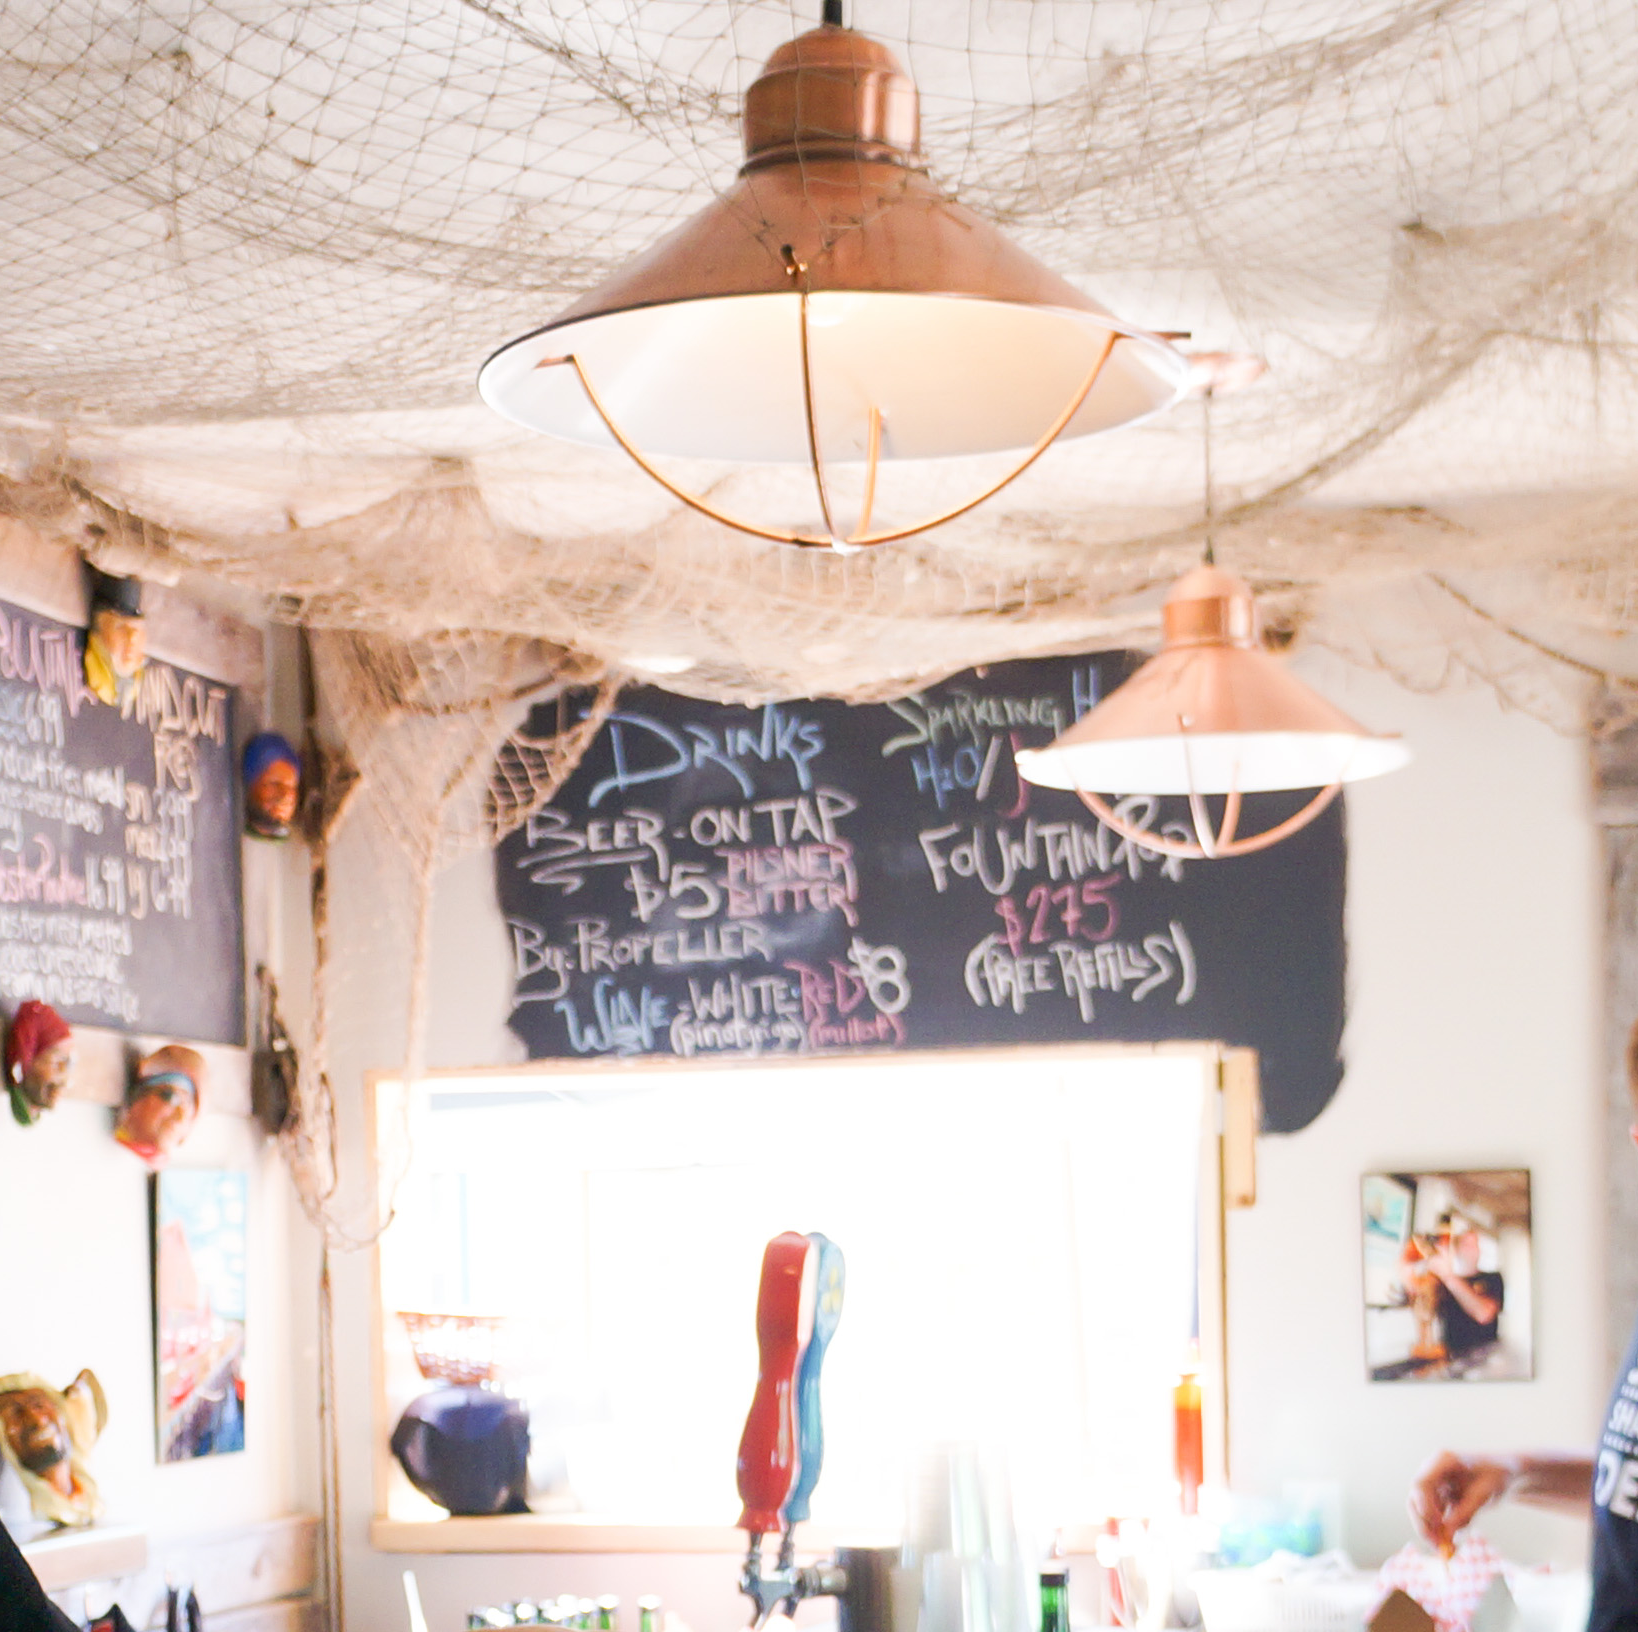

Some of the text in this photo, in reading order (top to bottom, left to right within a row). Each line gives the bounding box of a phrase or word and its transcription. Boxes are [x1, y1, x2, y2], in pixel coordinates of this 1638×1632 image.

[577, 702, 827, 809] DRINKS
[881, 688, 1062, 758] SPARKLING
[753, 785, 859, 847] TAP
[623, 863, 722, 923] $5
